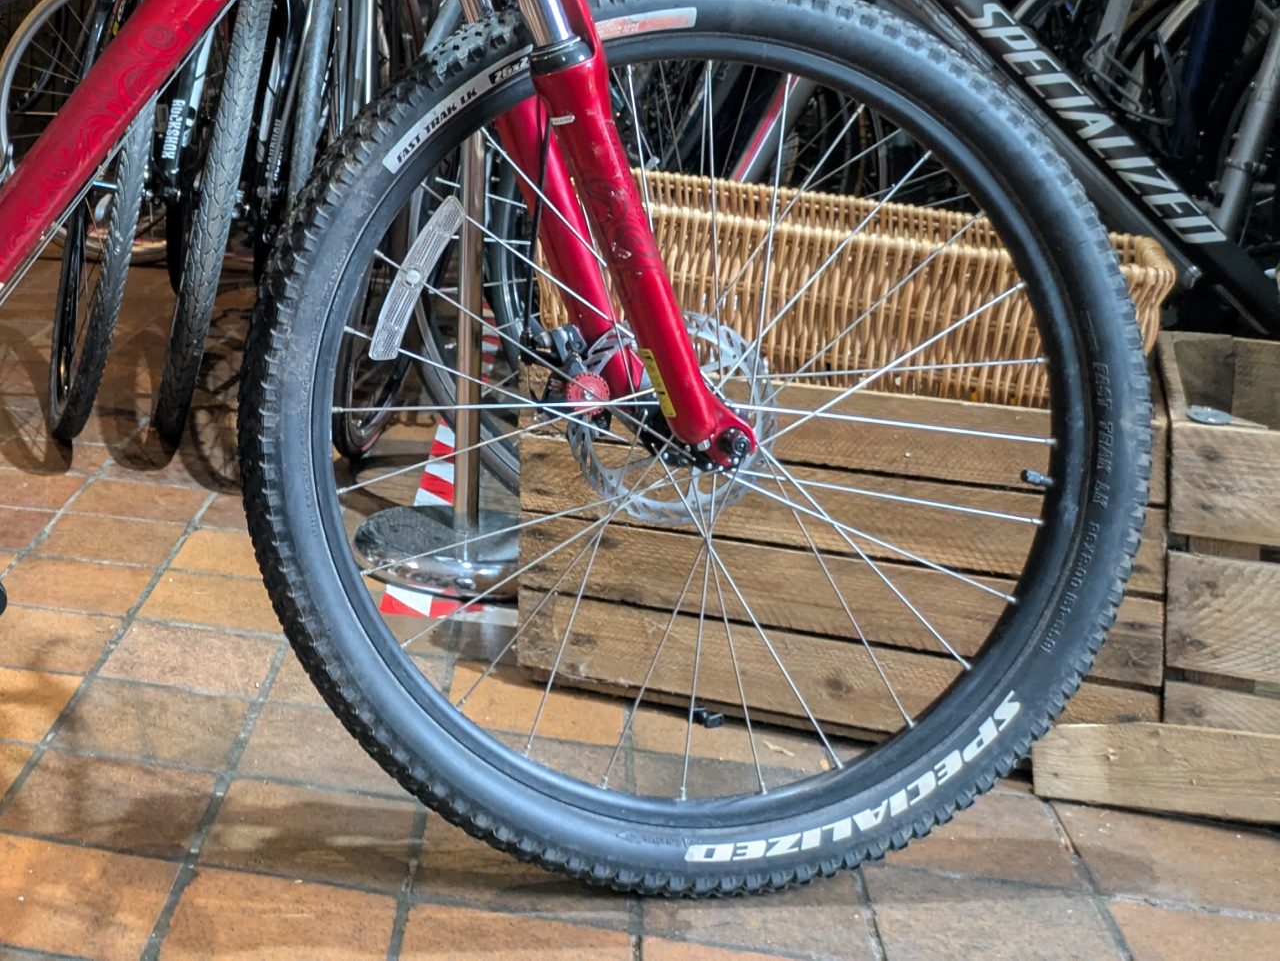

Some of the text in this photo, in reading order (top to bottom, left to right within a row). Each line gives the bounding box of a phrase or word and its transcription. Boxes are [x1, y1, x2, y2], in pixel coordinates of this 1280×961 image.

[397, 133, 422, 164] FAST
[423, 102, 457, 134] TRAK
[460, 88, 478, 105] LK
[954, 2, 1228, 244] SPECIALIZED
[1092, 361, 1113, 410] FAST
[1097, 421, 1114, 474] TRAK
[1092, 478, 1110, 510] LK
[684, 689, 1021, 862] SPECIALIZED
